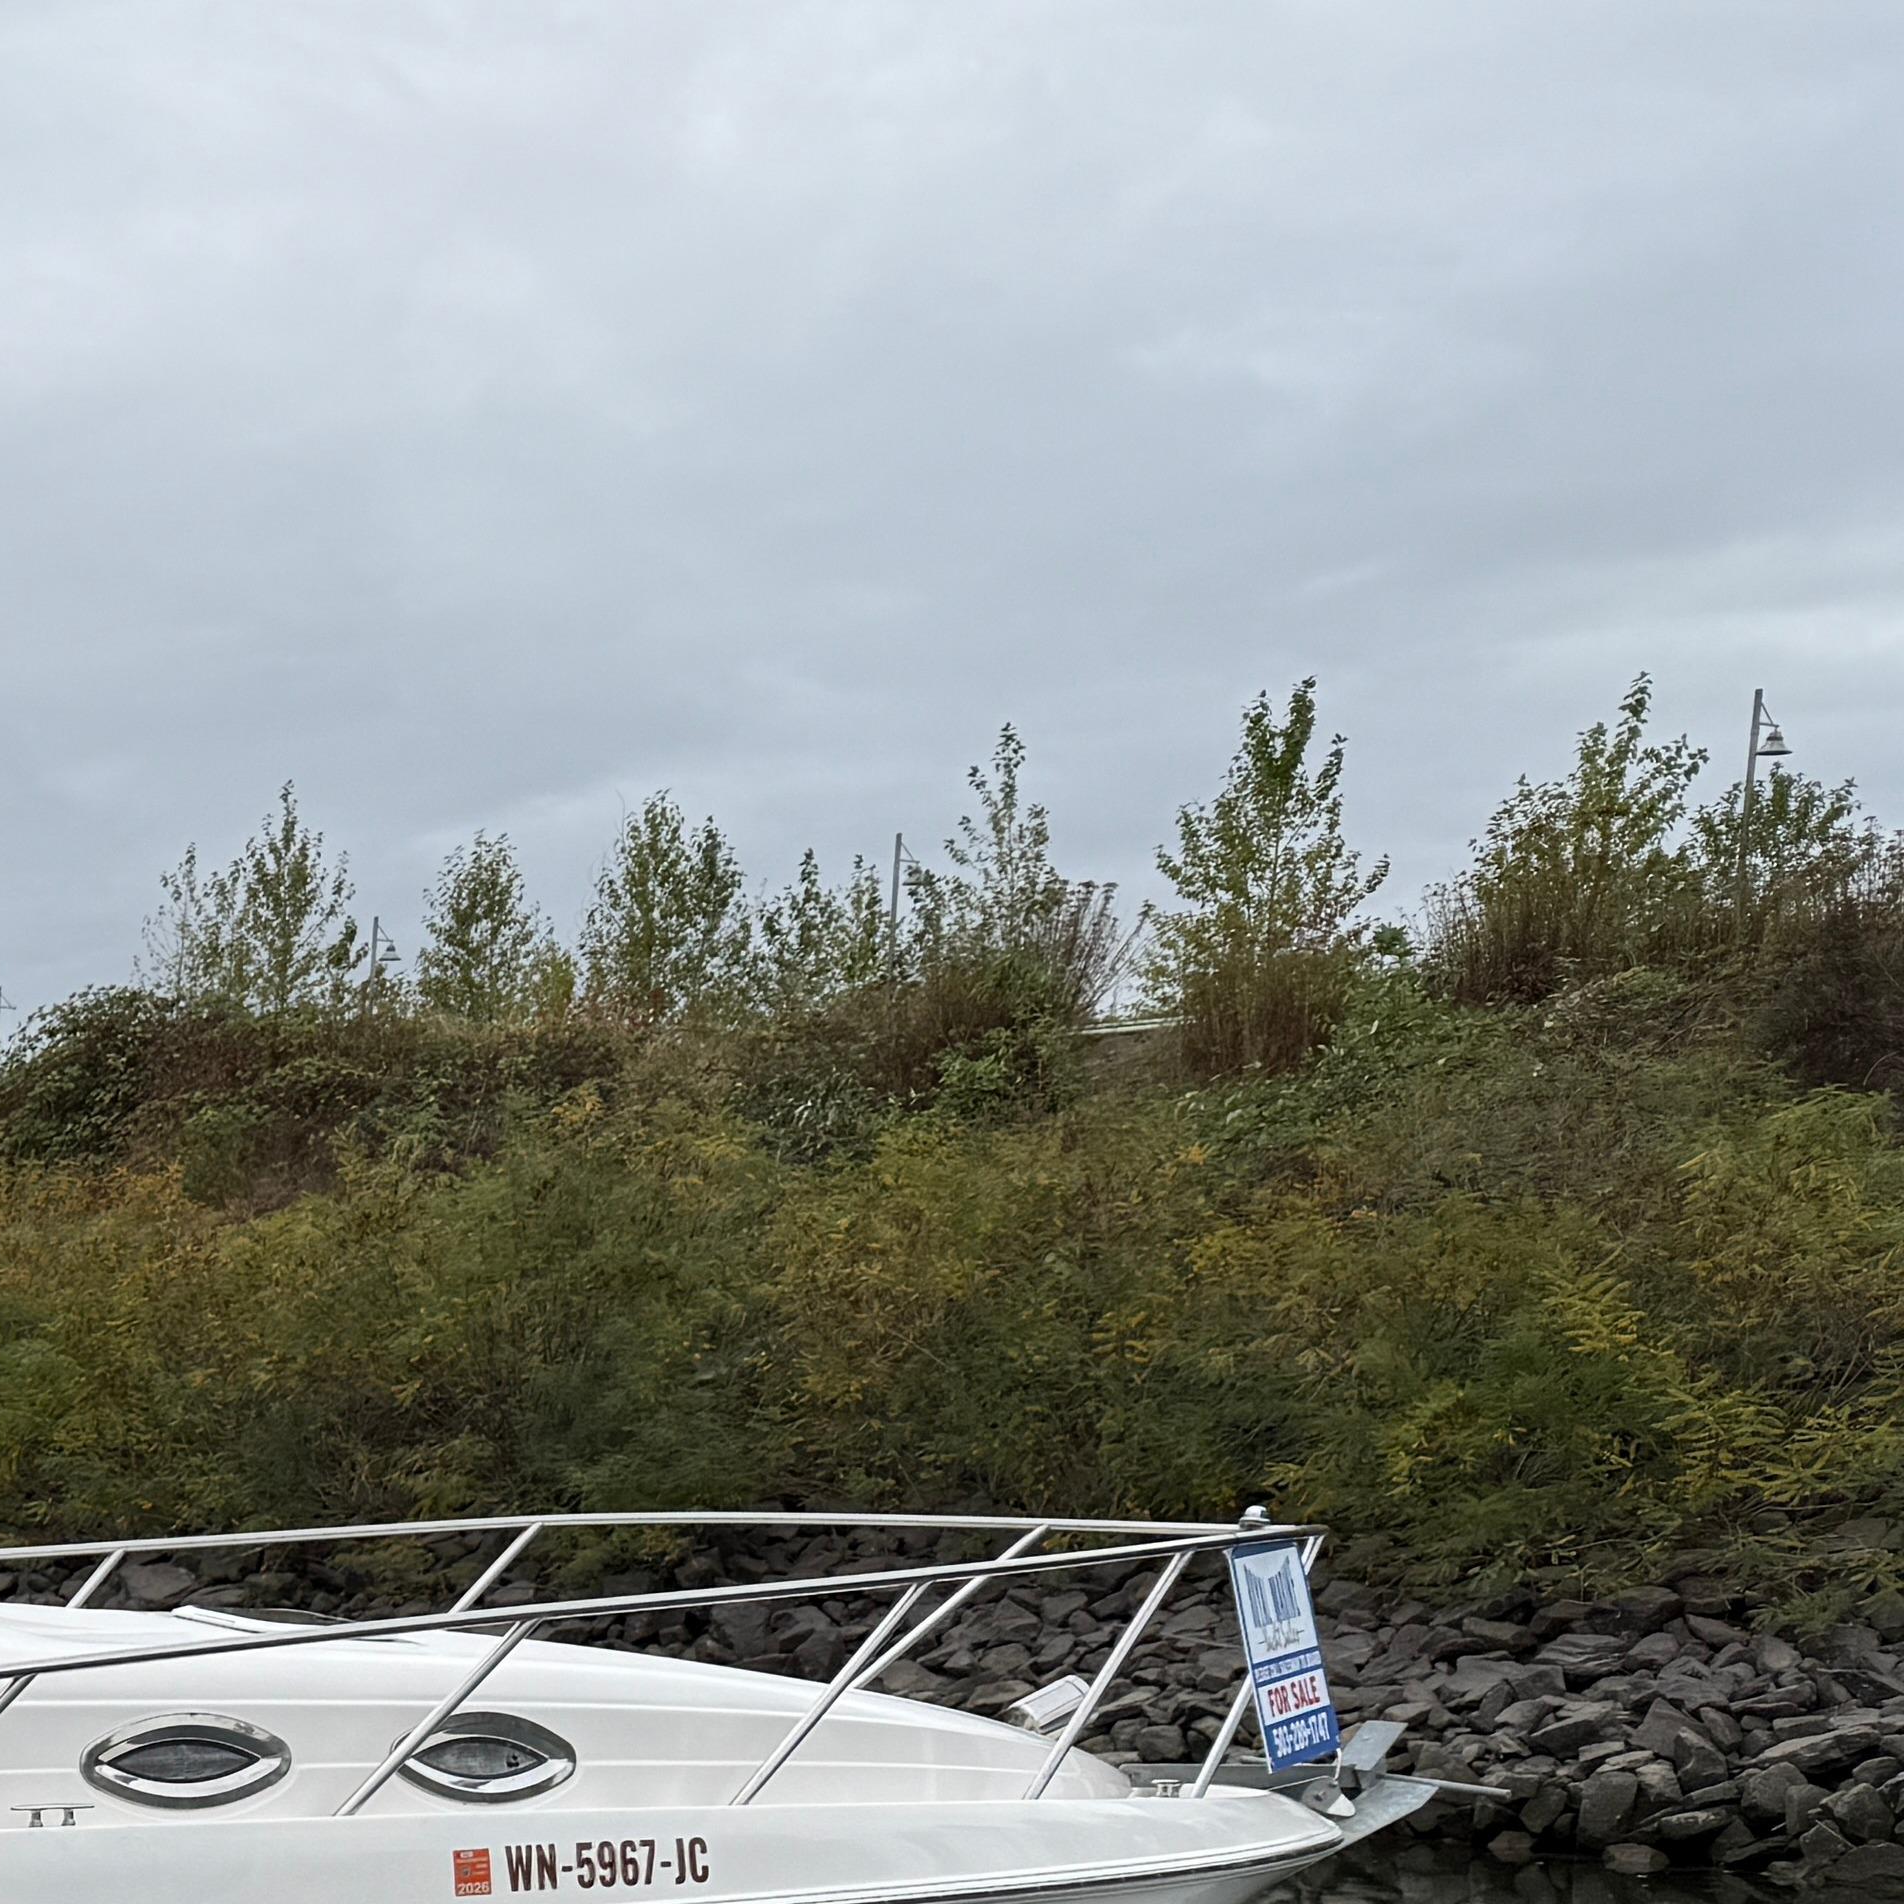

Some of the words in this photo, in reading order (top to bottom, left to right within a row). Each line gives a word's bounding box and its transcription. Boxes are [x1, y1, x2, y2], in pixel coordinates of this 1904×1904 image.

[1267, 1685, 1291, 1718] FOR
[1292, 1676, 1321, 1710] SALE
[504, 1836, 710, 1892] WN-5967-JC
[457, 1882, 490, 1896] 2026
